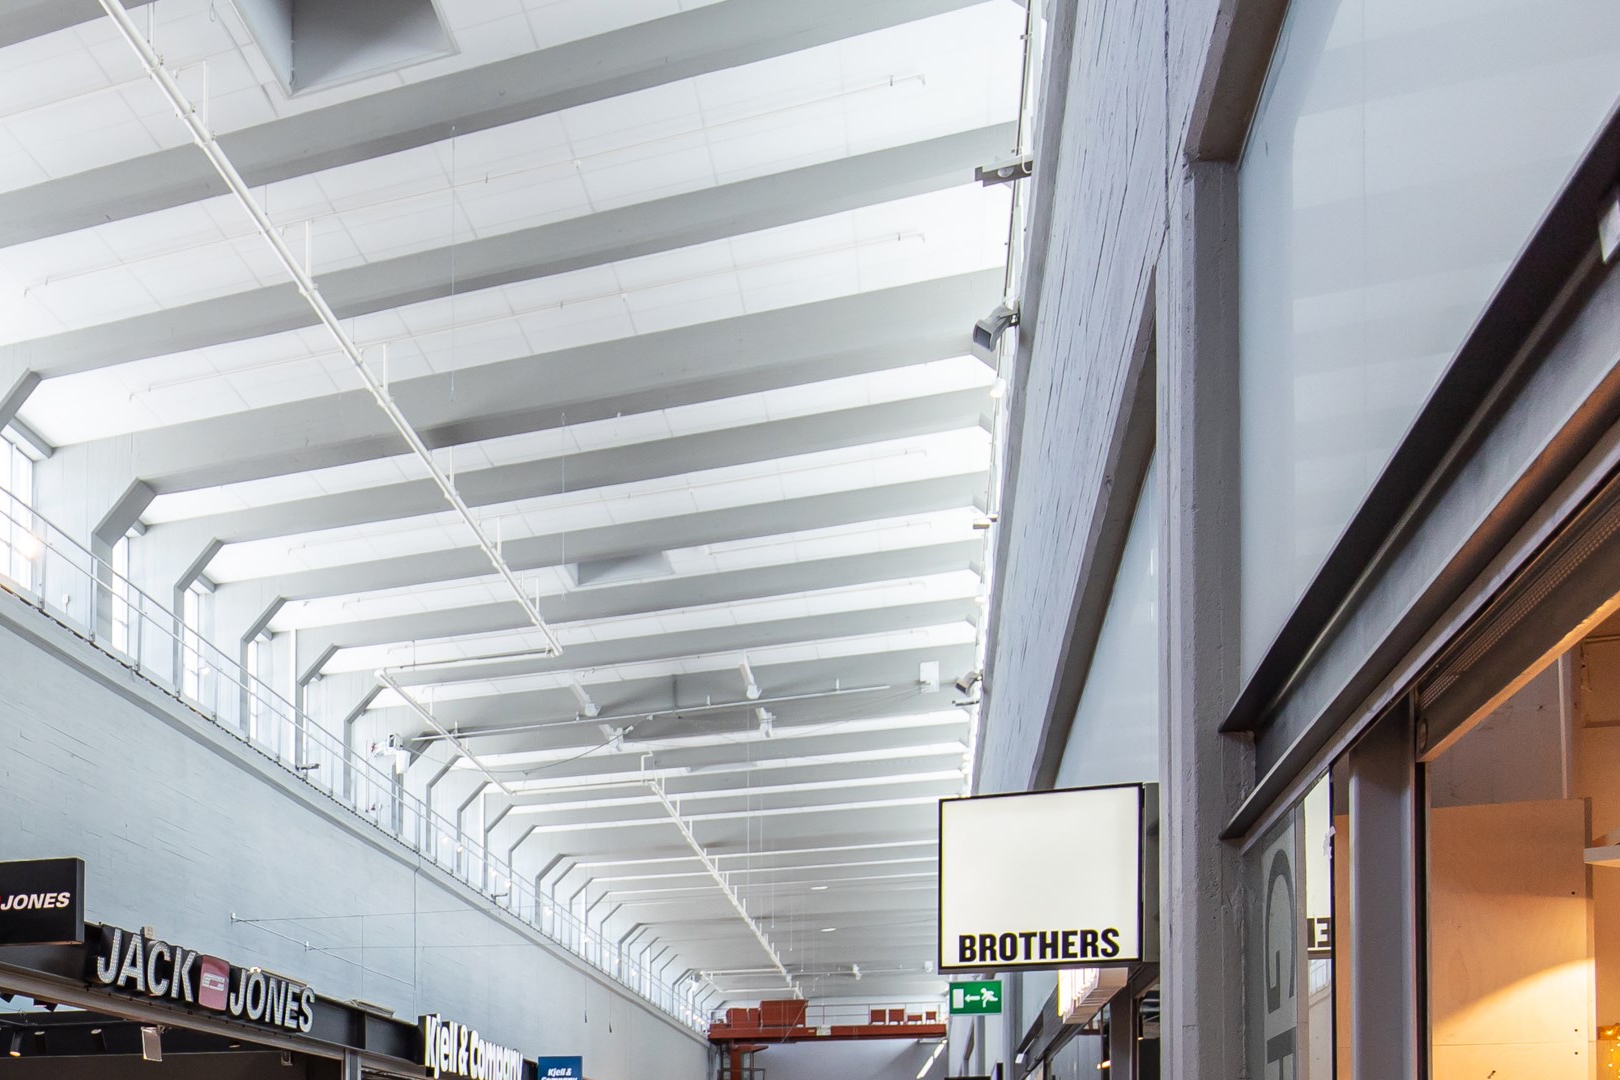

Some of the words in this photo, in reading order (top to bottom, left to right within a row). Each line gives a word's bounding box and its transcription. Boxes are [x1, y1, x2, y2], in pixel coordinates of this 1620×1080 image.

[0, 892, 71, 910] JONES
[959, 928, 1120, 963] BROTHERS
[97, 928, 198, 1002] JACK
[230, 967, 315, 1033] JONES
[424, 1013, 457, 1079] Kjell
[458, 1024, 469, 1077] &
[547, 1068, 565, 1077] Kjell
[565, 1068, 572, 1076] &
